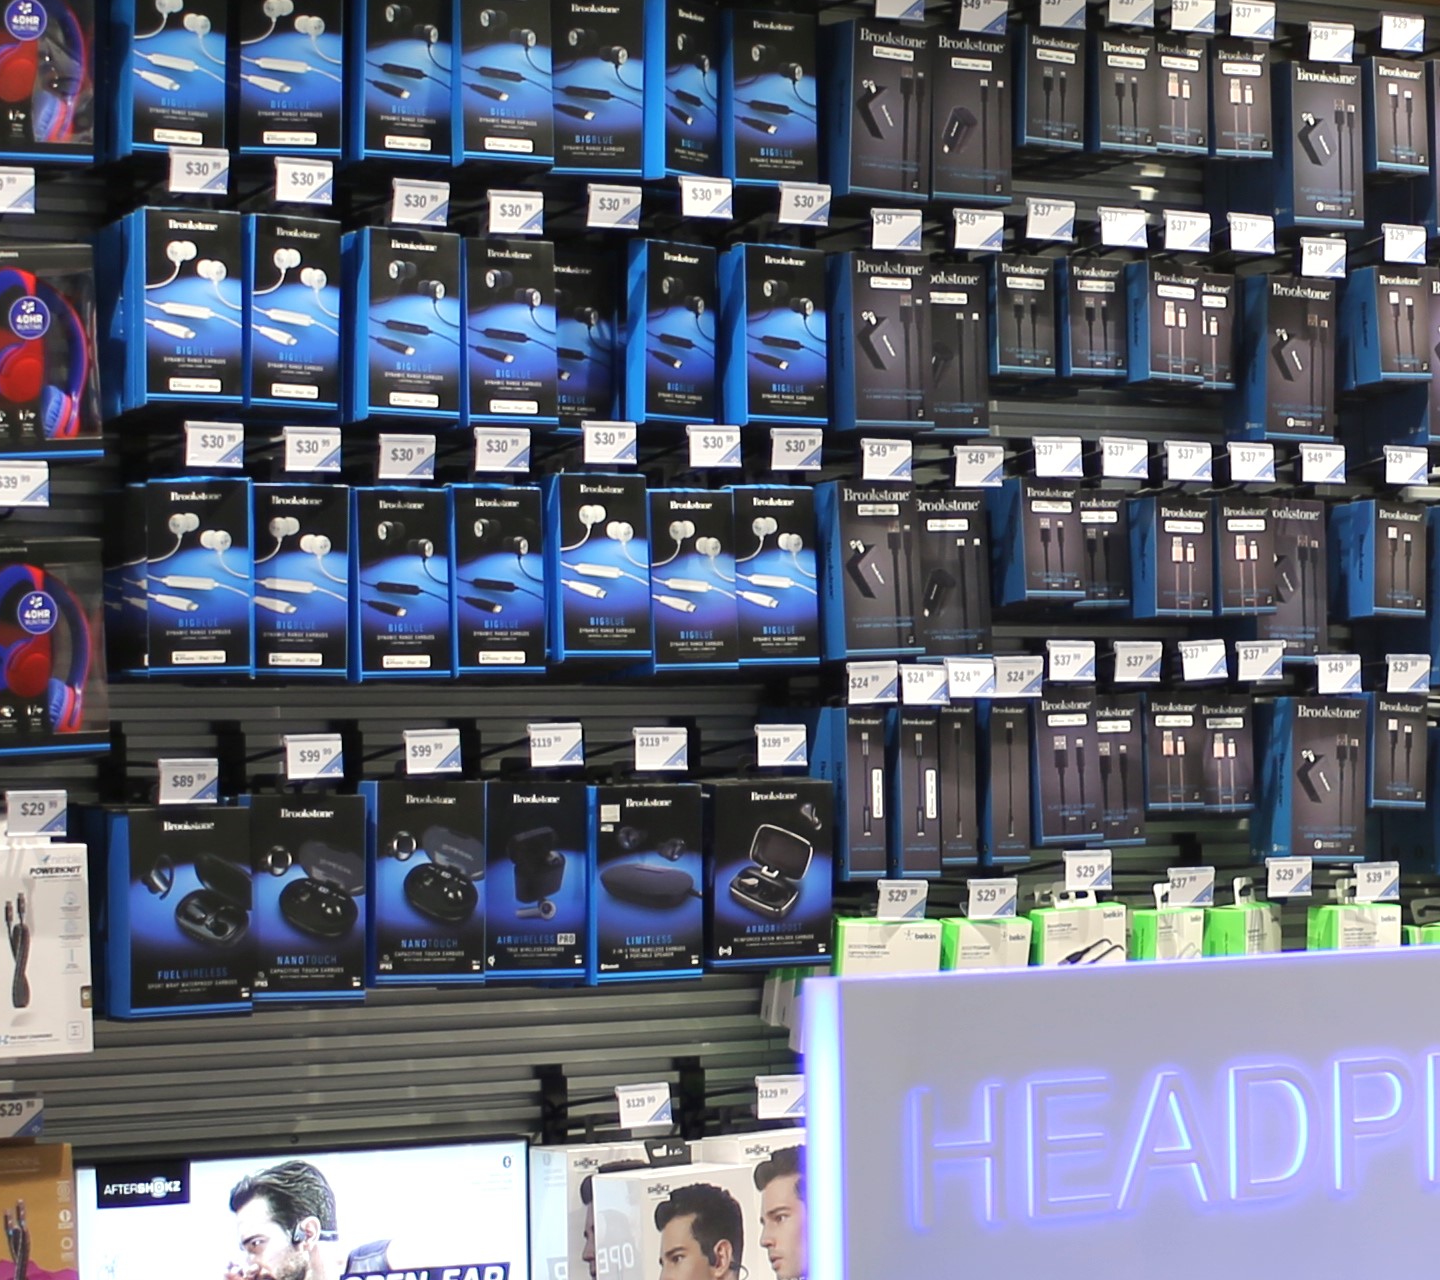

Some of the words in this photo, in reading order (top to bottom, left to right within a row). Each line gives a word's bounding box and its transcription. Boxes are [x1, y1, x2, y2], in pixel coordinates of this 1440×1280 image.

[860, 28, 927, 49] Brookstone
[938, 35, 1005, 53] Brookstone
[1296, 68, 1357, 85] Brookstone
[856, 260, 924, 276] Brookstone
[1272, 283, 1331, 300] Brookstone
[751, 791, 798, 802] Brookstone
[164, 821, 215, 832] Brookstone
[30, 865, 81, 876] POWERKNIT
[559, 934, 575, 945] PRO
[104, 1178, 182, 1197] AFTERSHOKZ
